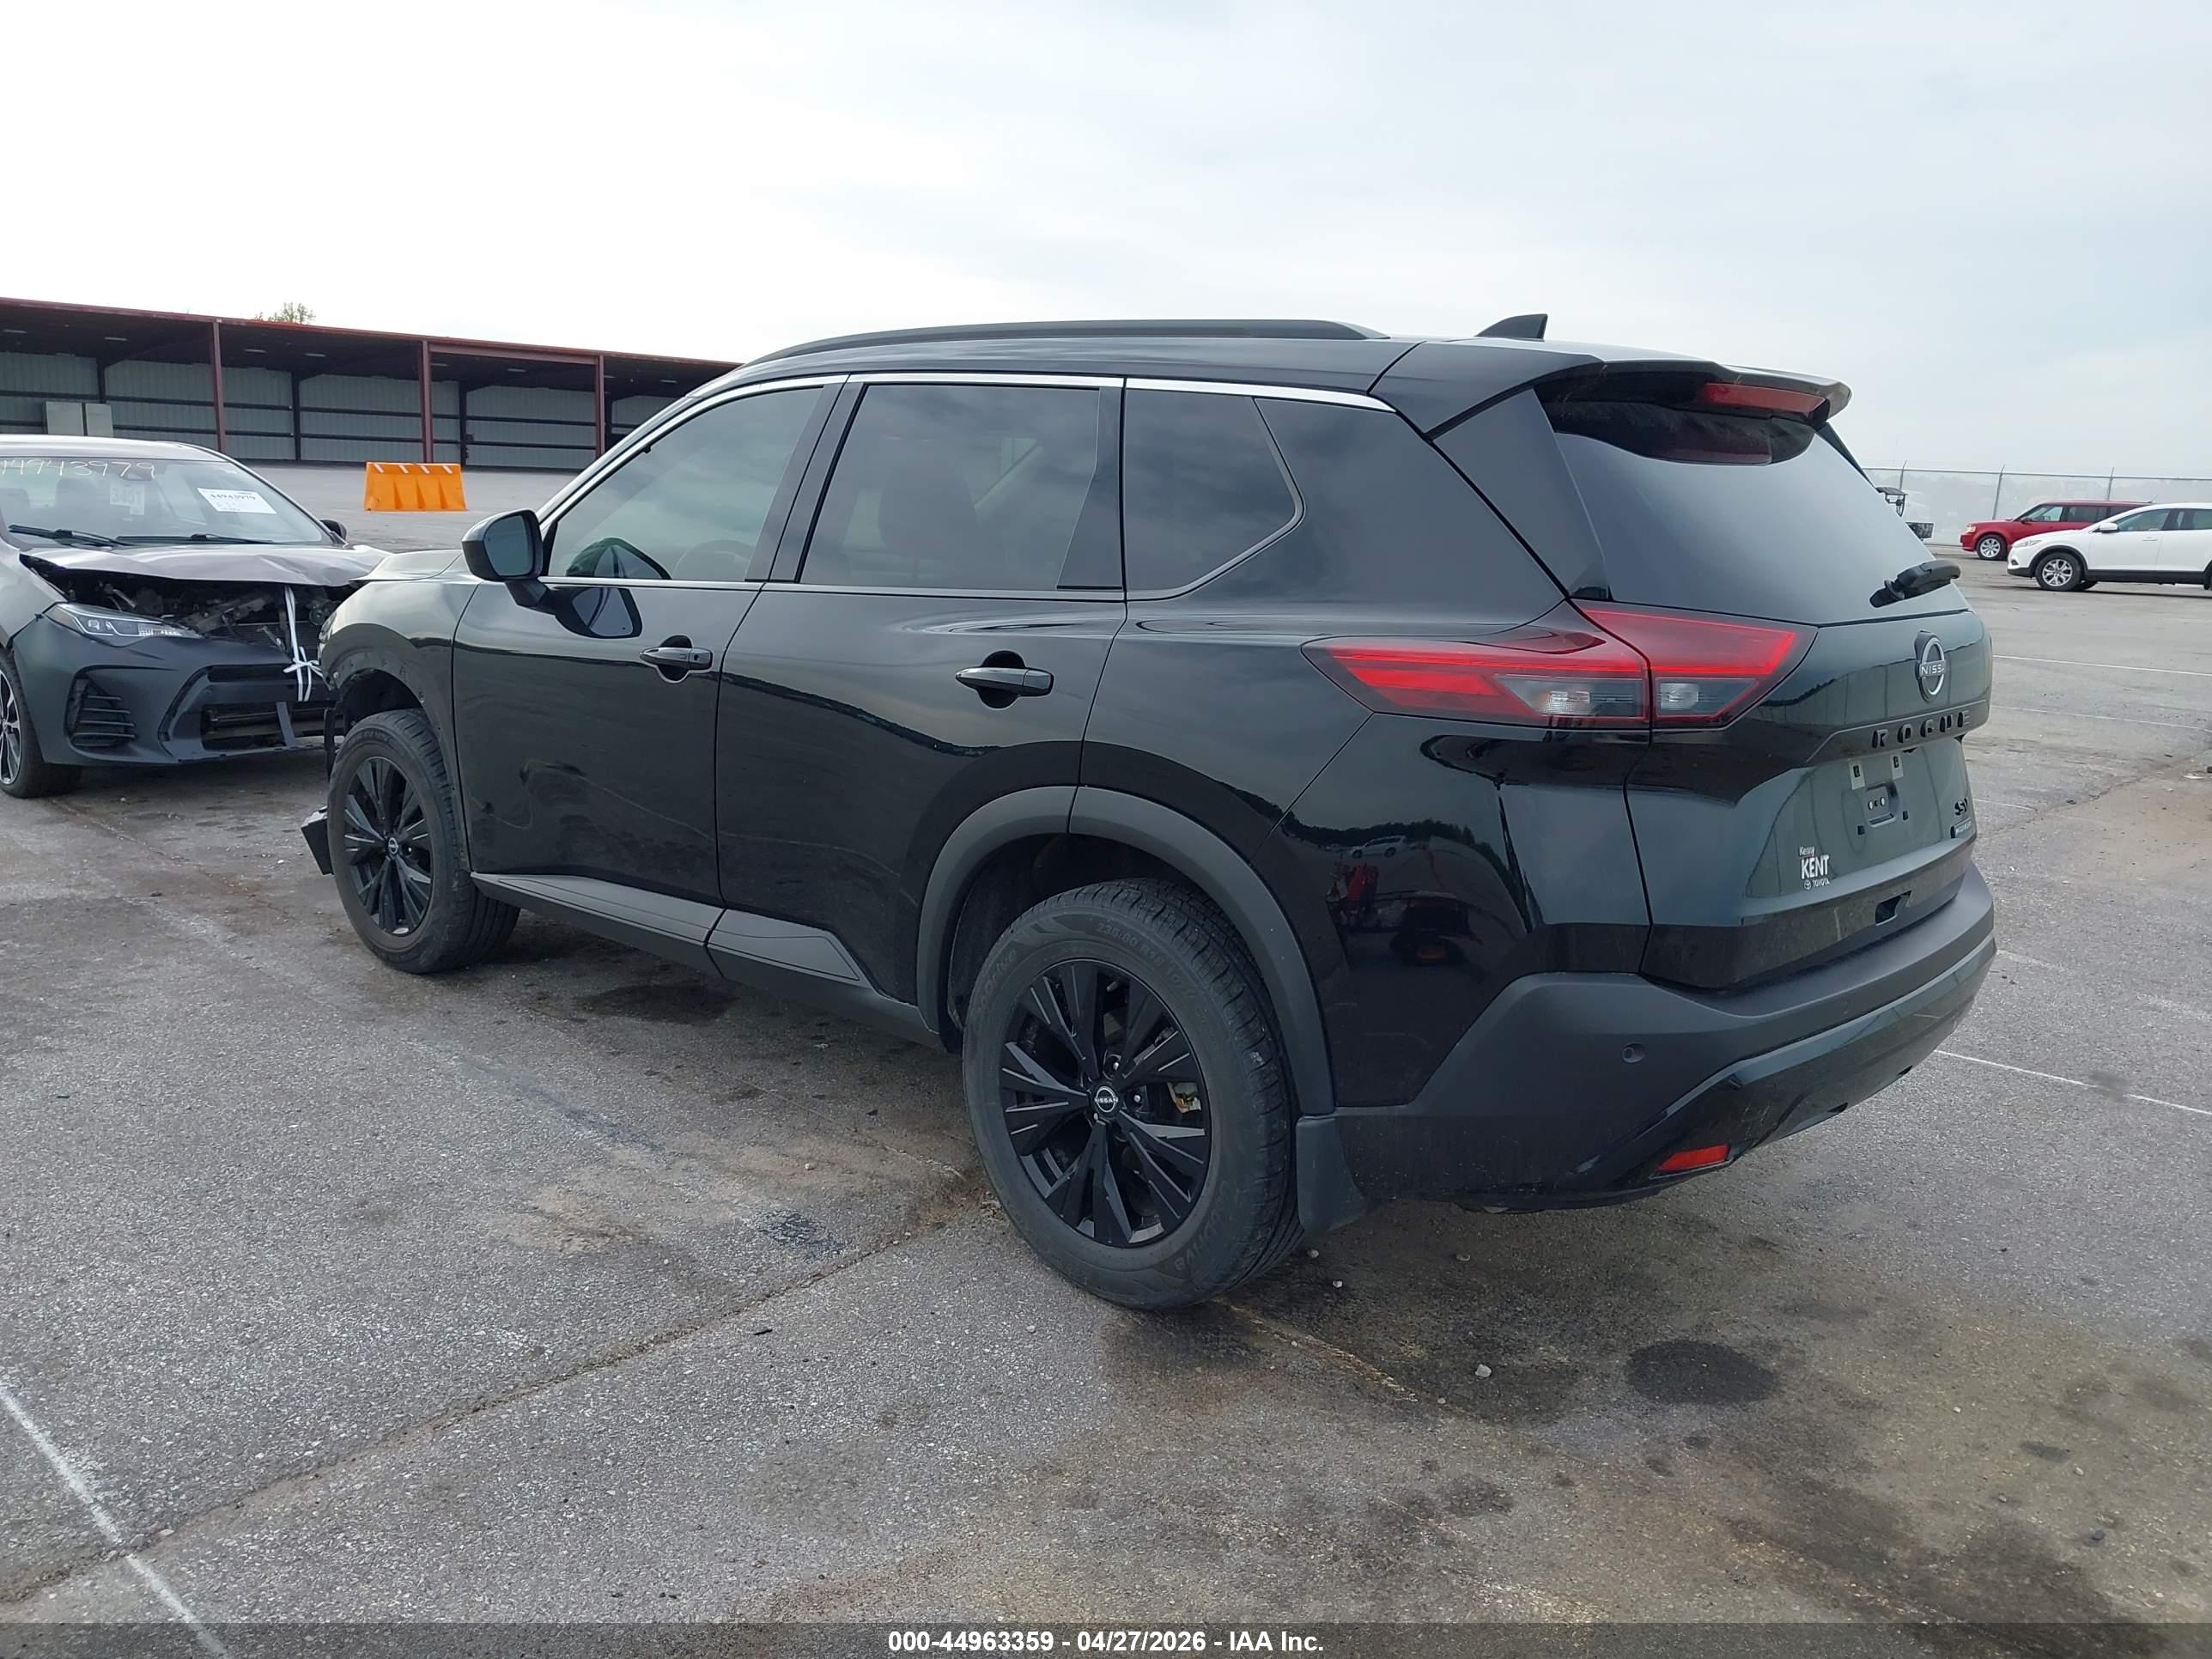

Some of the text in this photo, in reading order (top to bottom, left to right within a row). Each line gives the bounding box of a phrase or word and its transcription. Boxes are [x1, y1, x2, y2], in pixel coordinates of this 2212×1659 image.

[1871, 709, 1971, 749] ROGUE
[1801, 854, 1830, 879] KENT
[1812, 878, 1831, 888] TOYOTA
